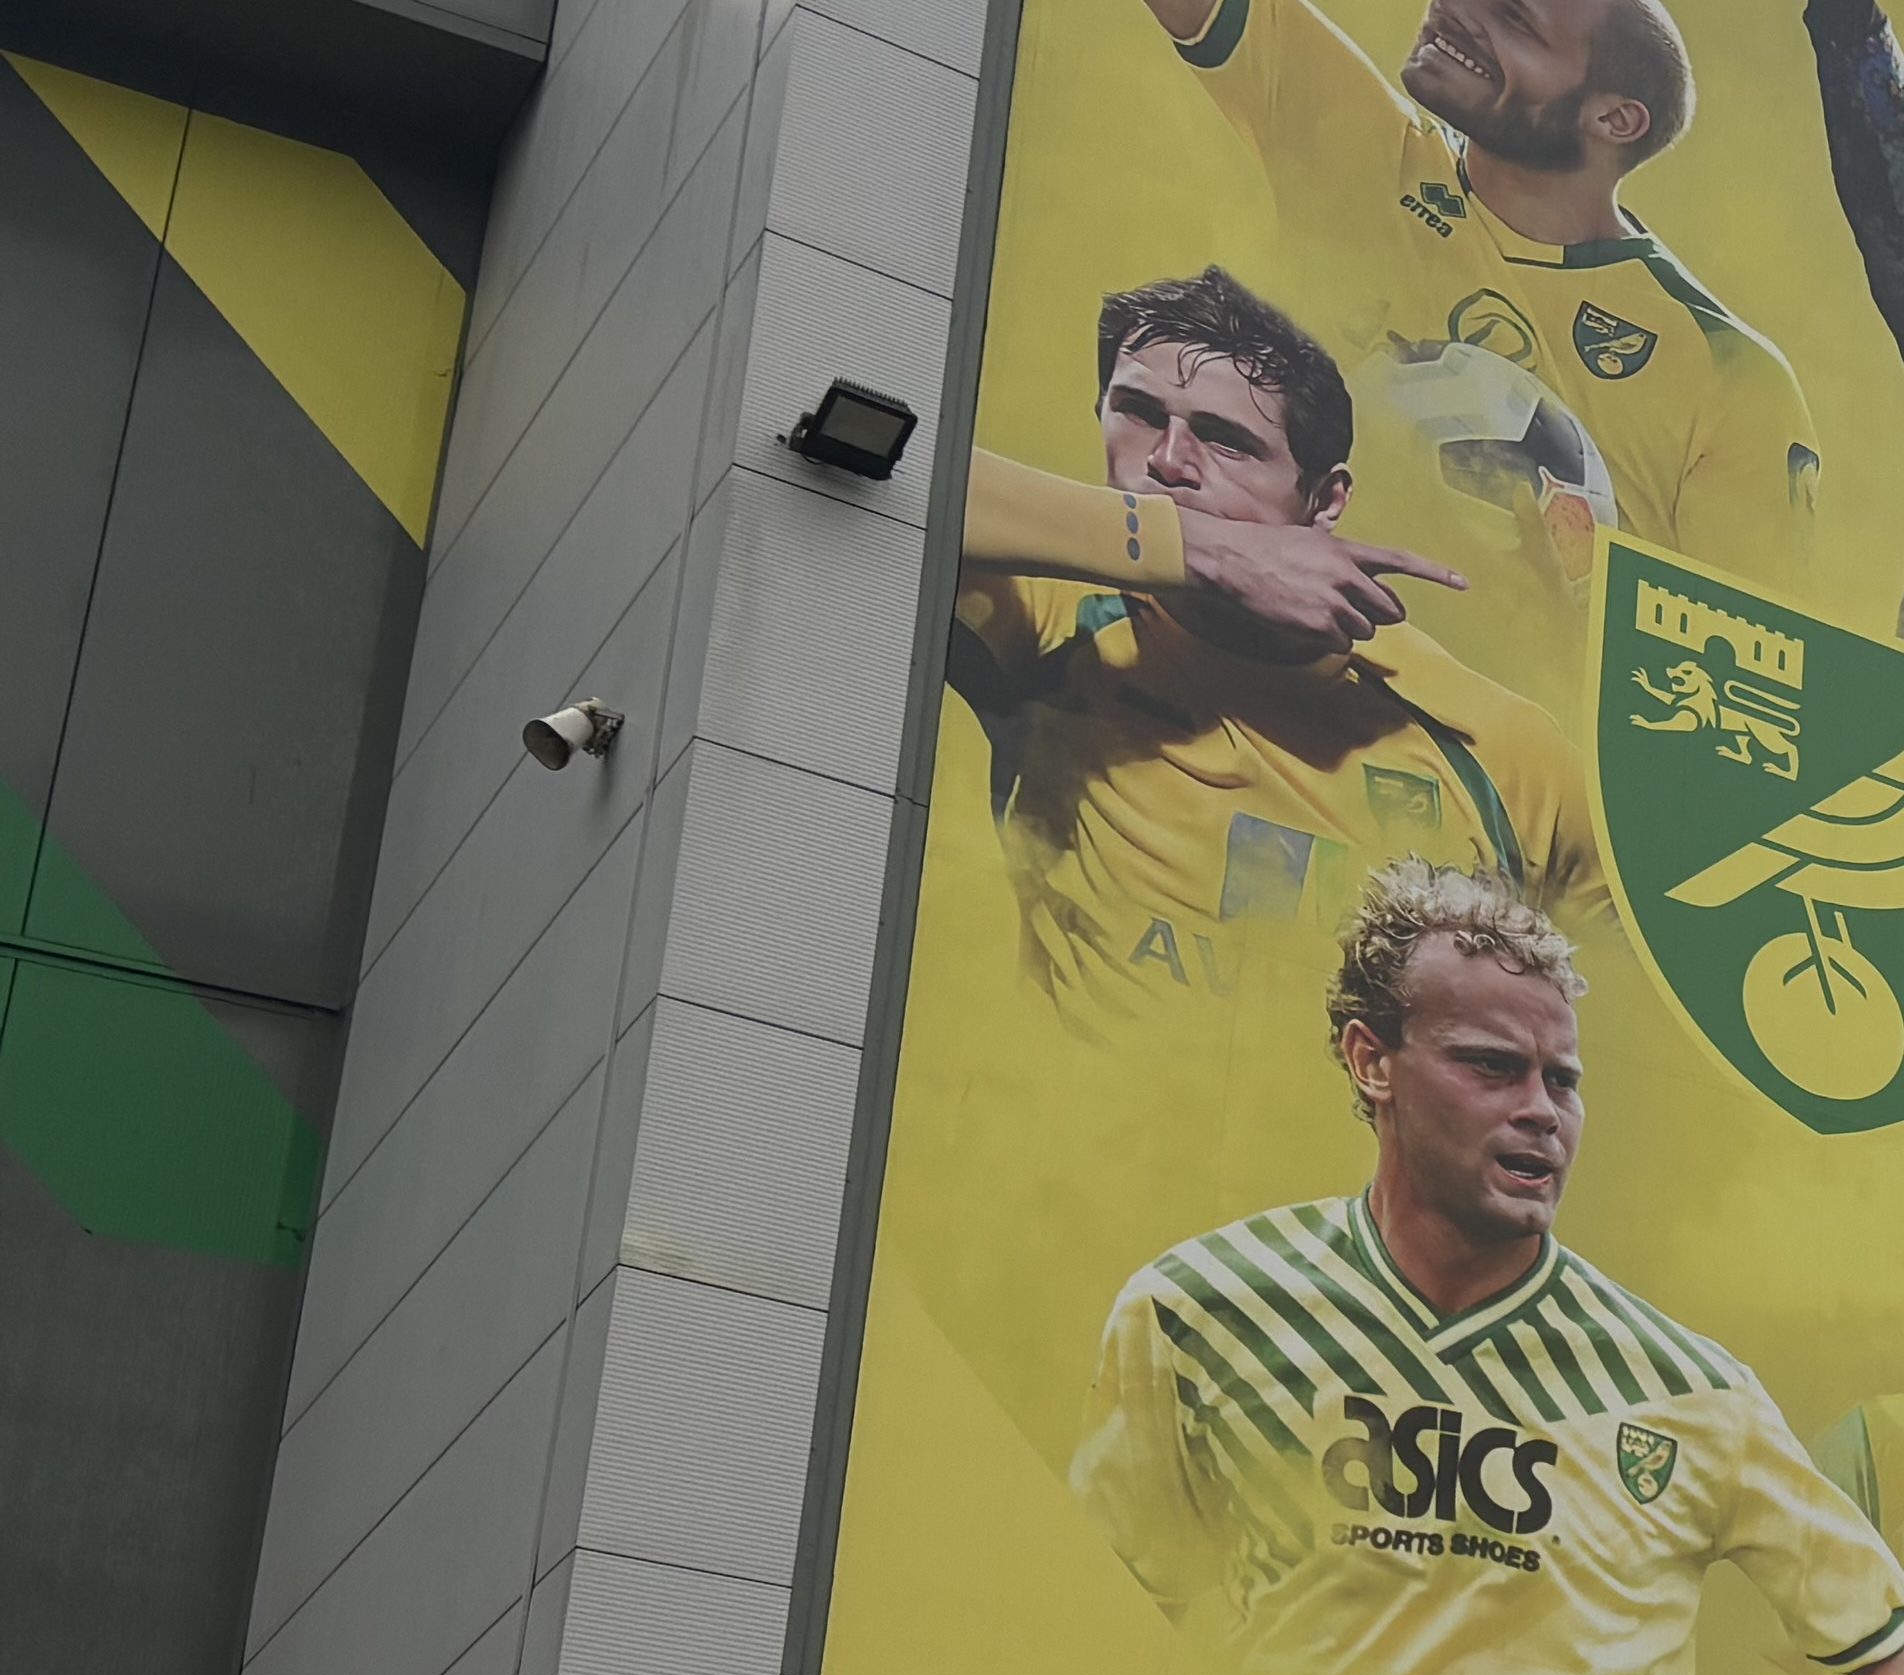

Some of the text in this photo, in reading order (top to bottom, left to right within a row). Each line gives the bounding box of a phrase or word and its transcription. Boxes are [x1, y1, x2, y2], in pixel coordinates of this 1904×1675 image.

[1400, 194, 1453, 238] errea
[1322, 1395, 1558, 1534] asics
[1331, 1523, 1541, 1572] SPORTS SHOES
